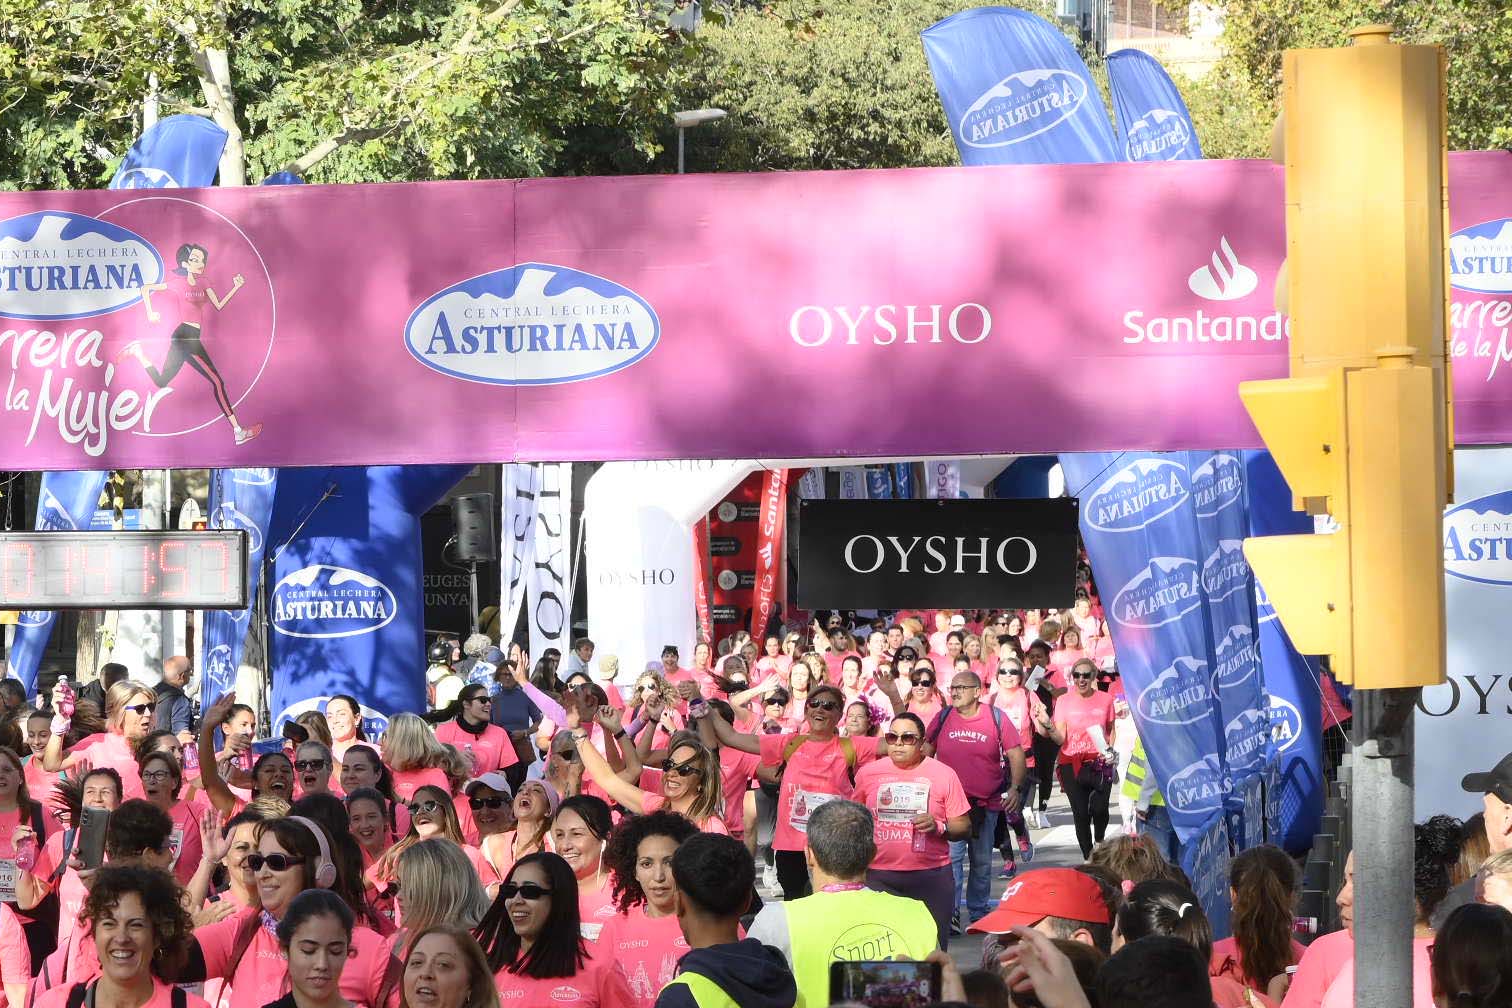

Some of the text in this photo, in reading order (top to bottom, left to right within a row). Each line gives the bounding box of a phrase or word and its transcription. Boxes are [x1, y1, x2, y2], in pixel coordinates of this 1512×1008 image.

[66, 245, 140, 258] LECHERA
[463, 304, 632, 318] CENTRAL LECHERA
[424, 311, 641, 356] ASTURIANA
[789, 302, 994, 348] OYSHO
[1122, 310, 1291, 345] Santand
[6, 371, 29, 412] la
[25, 360, 174, 457] Mujer
[843, 534, 1038, 577] OYSHO
[286, 589, 382, 599] CENTRAL LECHERA
[274, 595, 388, 622] ASTURIANA
[877, 830, 912, 841] SUMA
[619, 939, 649, 950] OYSHO
